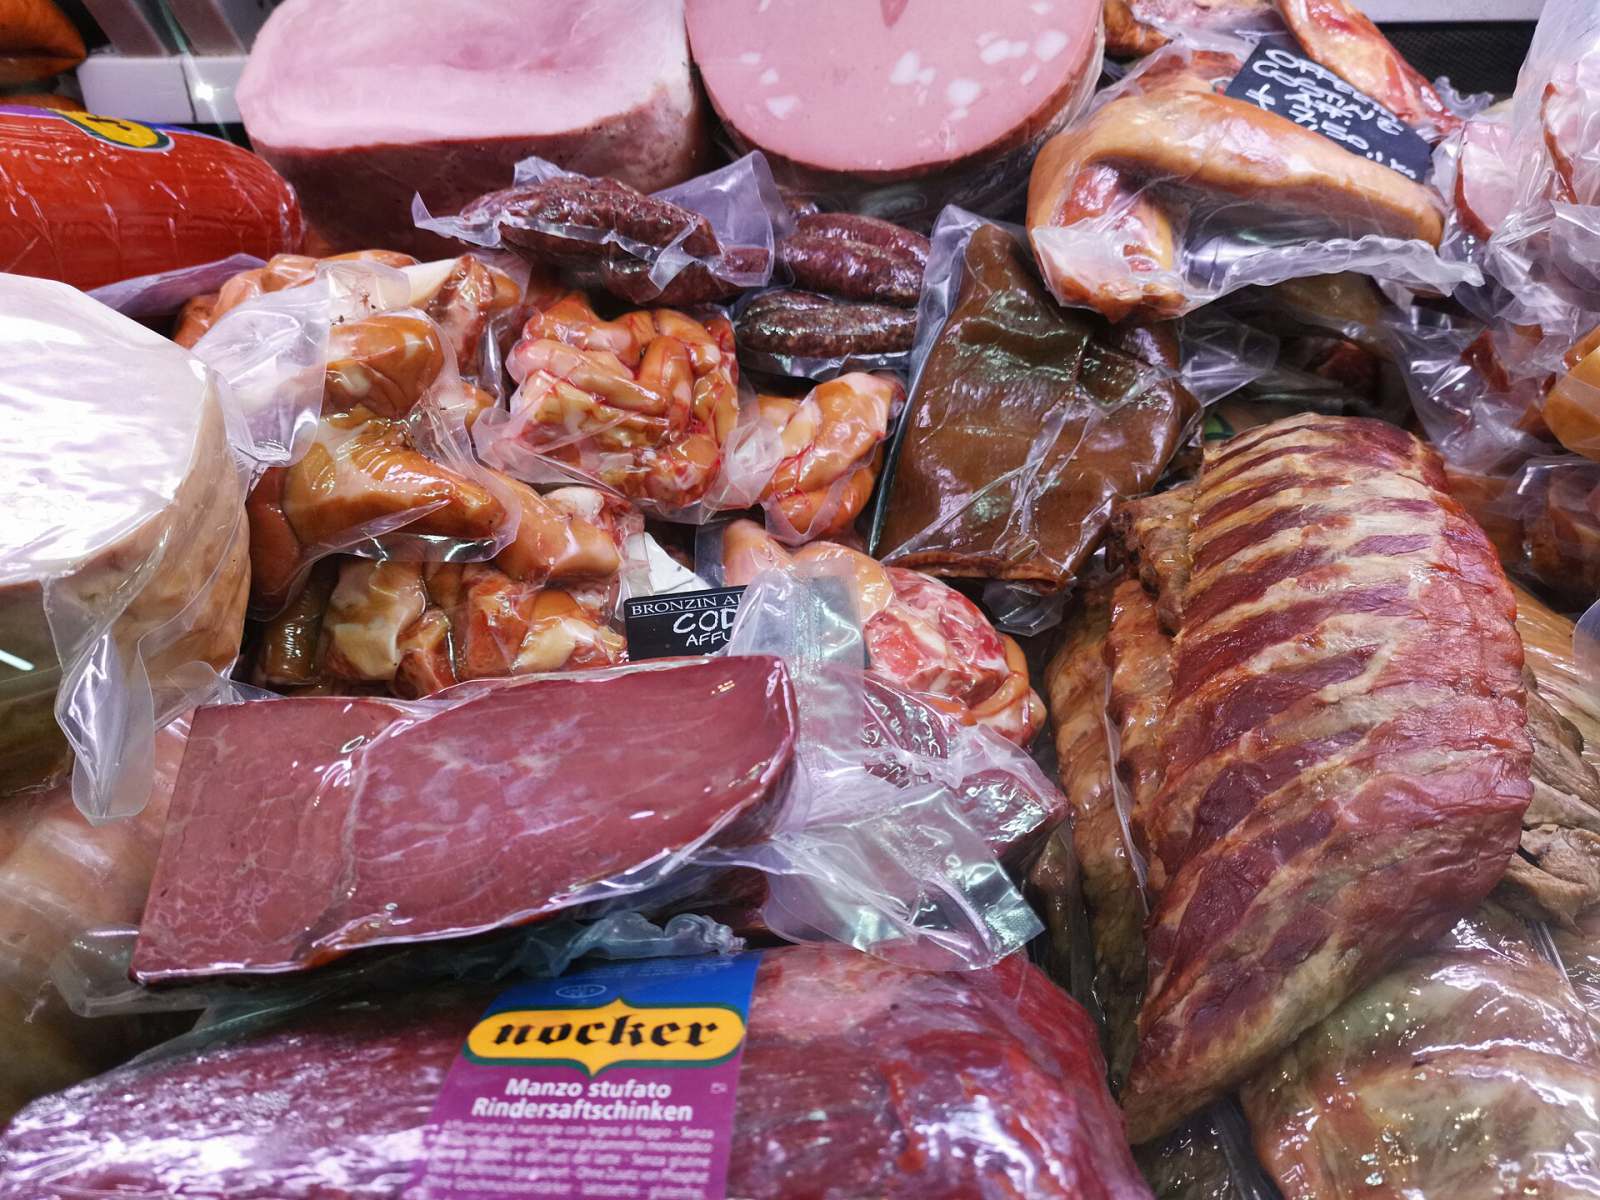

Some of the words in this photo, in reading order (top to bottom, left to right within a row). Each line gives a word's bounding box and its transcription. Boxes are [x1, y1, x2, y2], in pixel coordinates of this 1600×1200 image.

[1252, 60, 1404, 136] COSTINE
[631, 596, 718, 616] BRONZIN
[673, 607, 738, 634] COD
[686, 631, 731, 647] AFFU
[493, 1015, 718, 1047] nocker
[505, 1078, 582, 1098] Manzo
[587, 1080, 672, 1099] stufato
[471, 1097, 693, 1122] Rindersaftschinken
